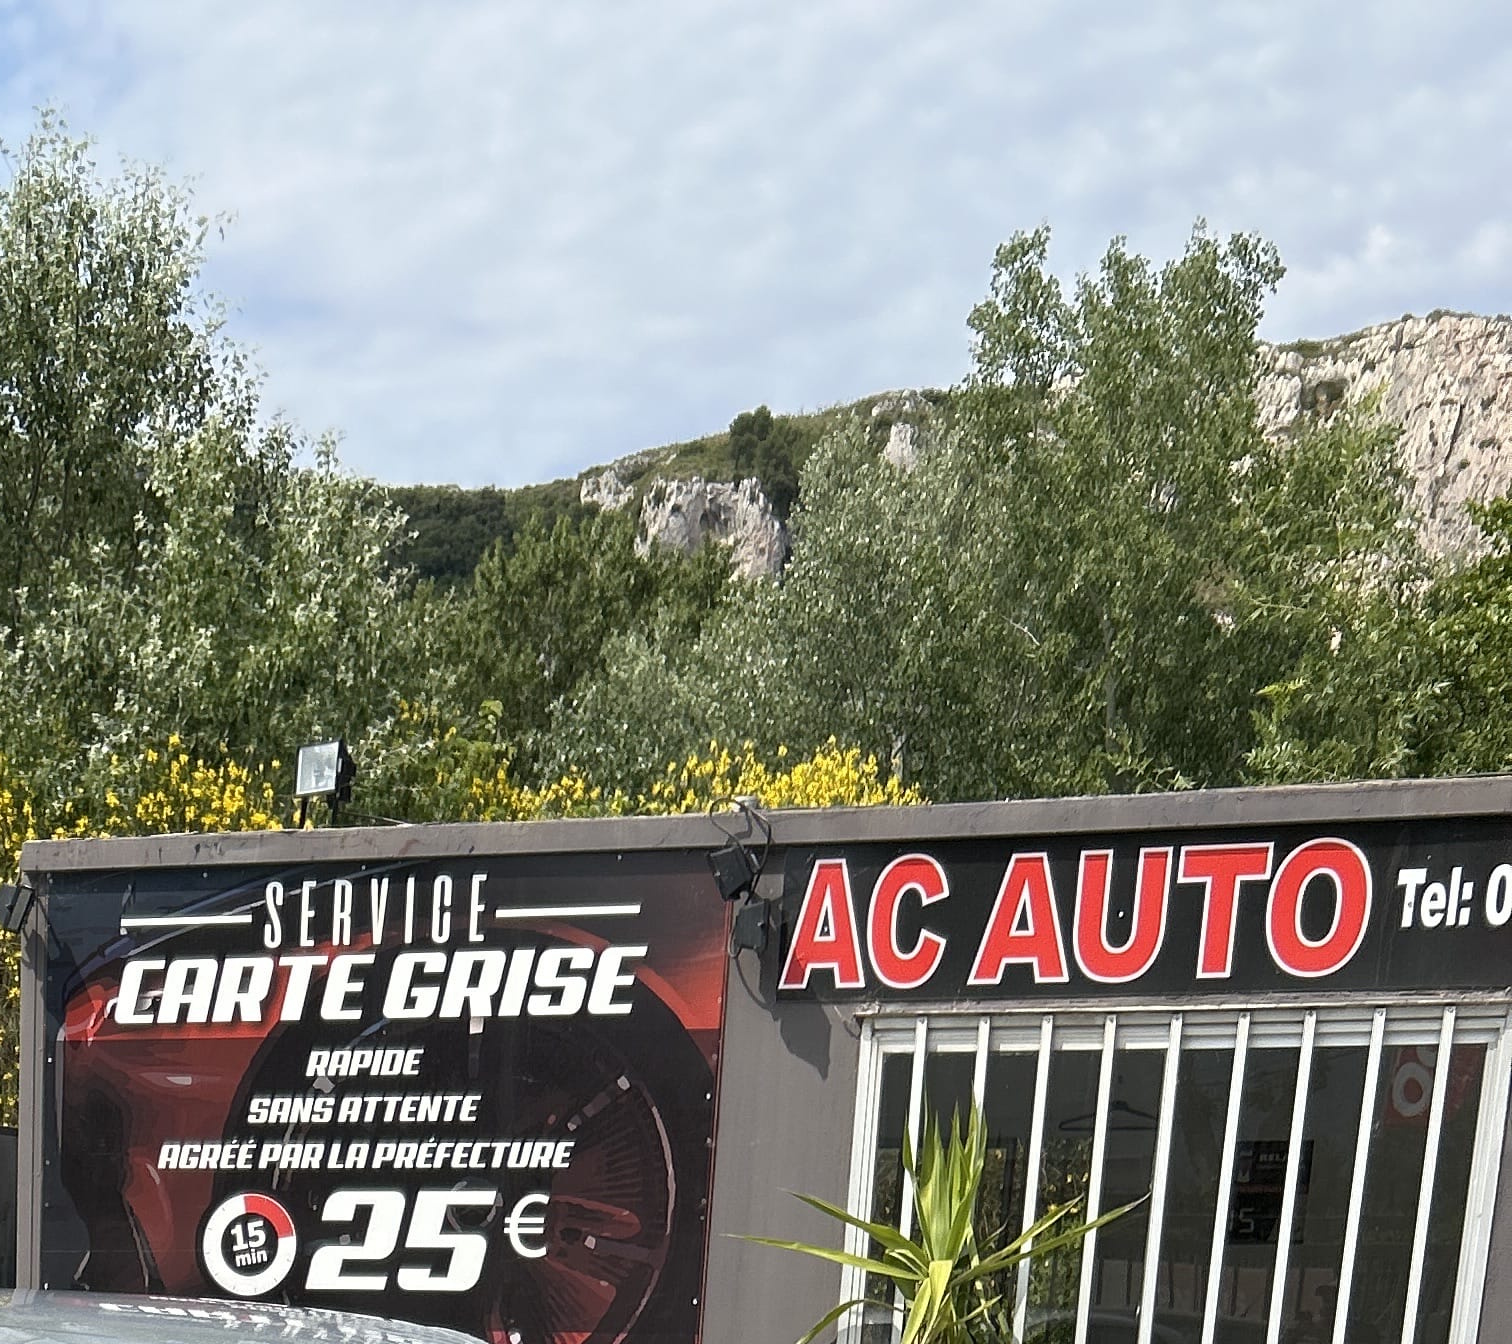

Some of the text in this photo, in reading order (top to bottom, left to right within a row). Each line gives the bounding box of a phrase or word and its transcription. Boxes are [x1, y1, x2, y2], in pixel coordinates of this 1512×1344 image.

[264, 873, 488, 949] SERVICE
[779, 853, 951, 990] AC
[967, 837, 1373, 987] AUTO
[1397, 866, 1474, 928] Tel:
[114, 945, 649, 1025] CARTE GRISE
[306, 1048, 425, 1077] RAPIDE
[247, 1095, 482, 1124] SANS ATTENTE
[157, 1136, 576, 1169] AGRÉÉ PAR LA PRÉFECTURE
[231, 1221, 267, 1251] 15
[305, 1190, 550, 1291] 25 €
[235, 1248, 268, 1267] min
